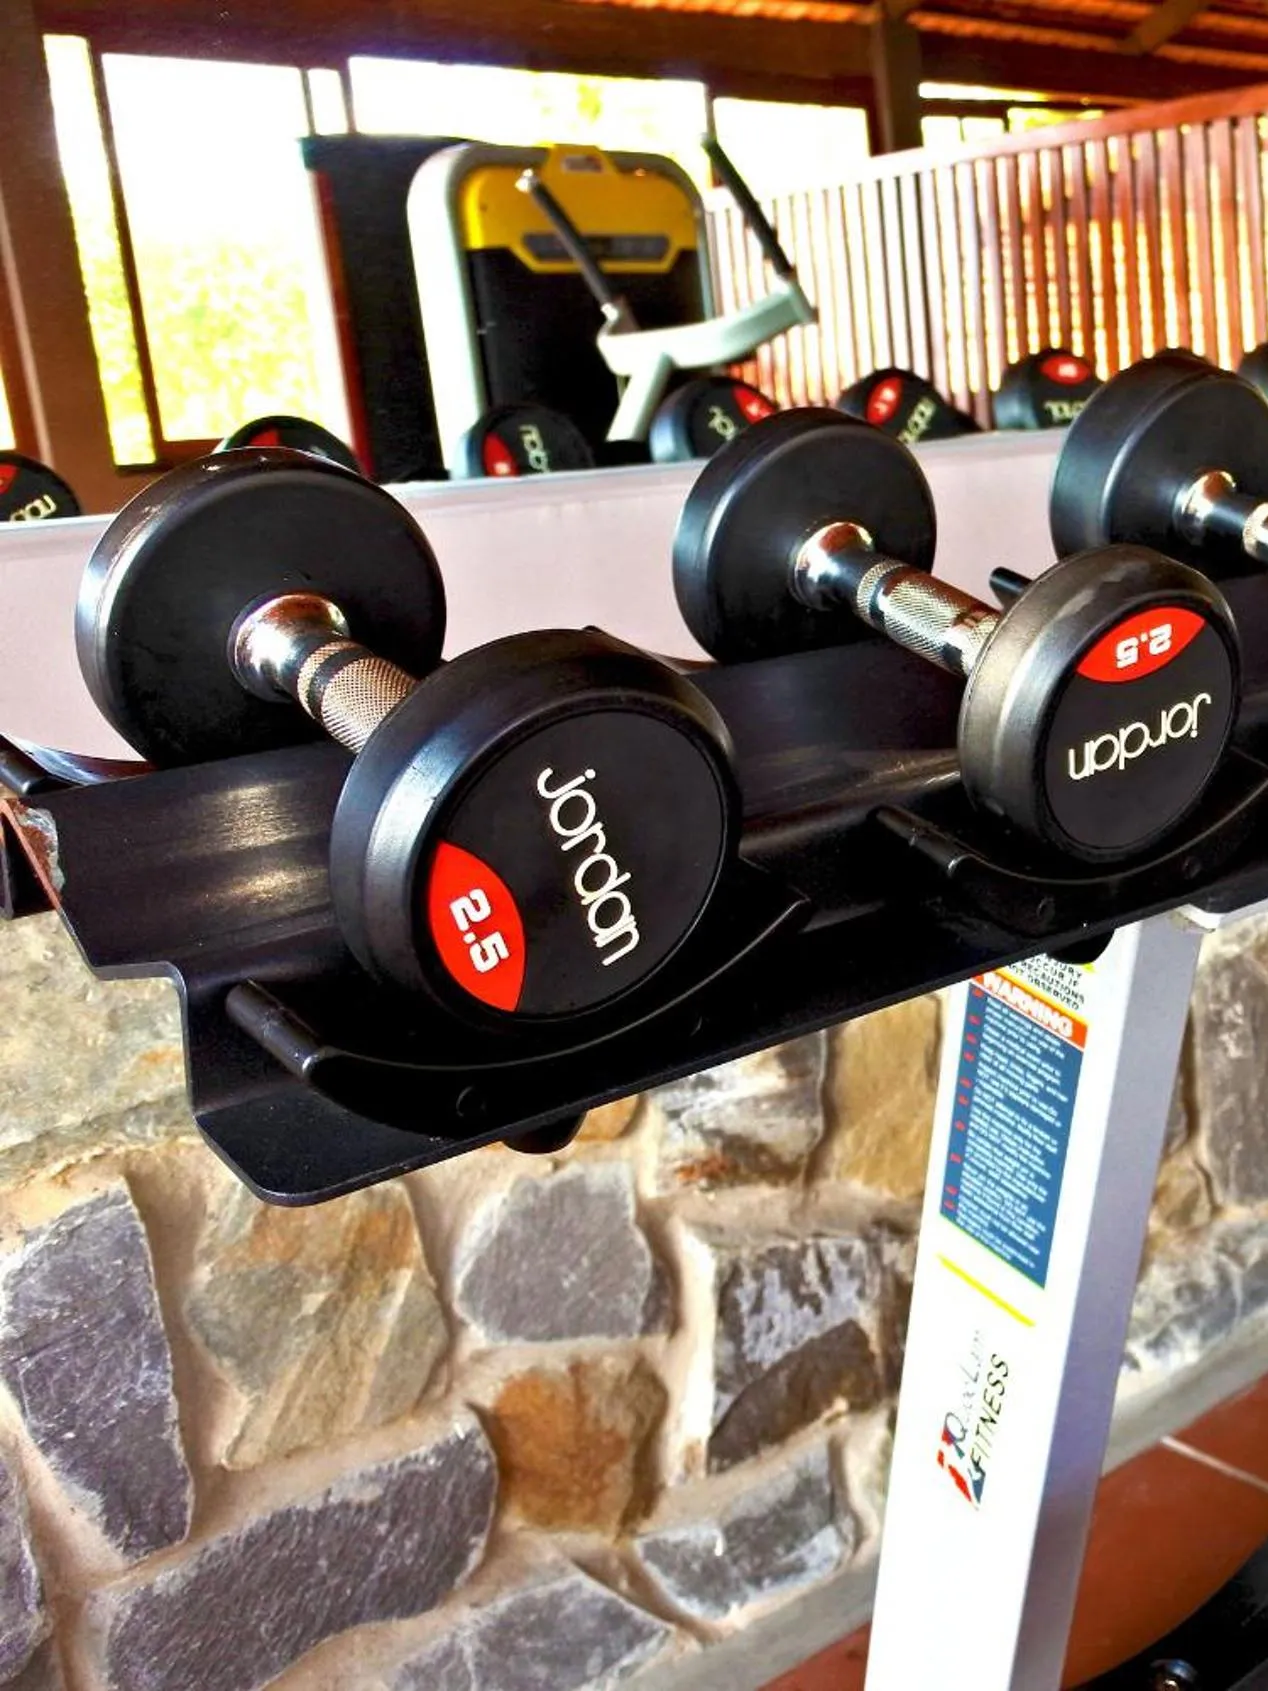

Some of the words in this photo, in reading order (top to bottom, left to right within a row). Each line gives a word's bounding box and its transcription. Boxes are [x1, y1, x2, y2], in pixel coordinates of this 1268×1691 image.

[1116, 623, 1173, 669] 2.5
[1068, 692, 1212, 781] jordan
[537, 767, 641, 967] jordan
[450, 888, 510, 974] 2.5
[983, 971, 1074, 1039] WARNING
[1021, 960, 1085, 1005] RECAUTIONS
[970, 1353, 1009, 1474] FITNESS
